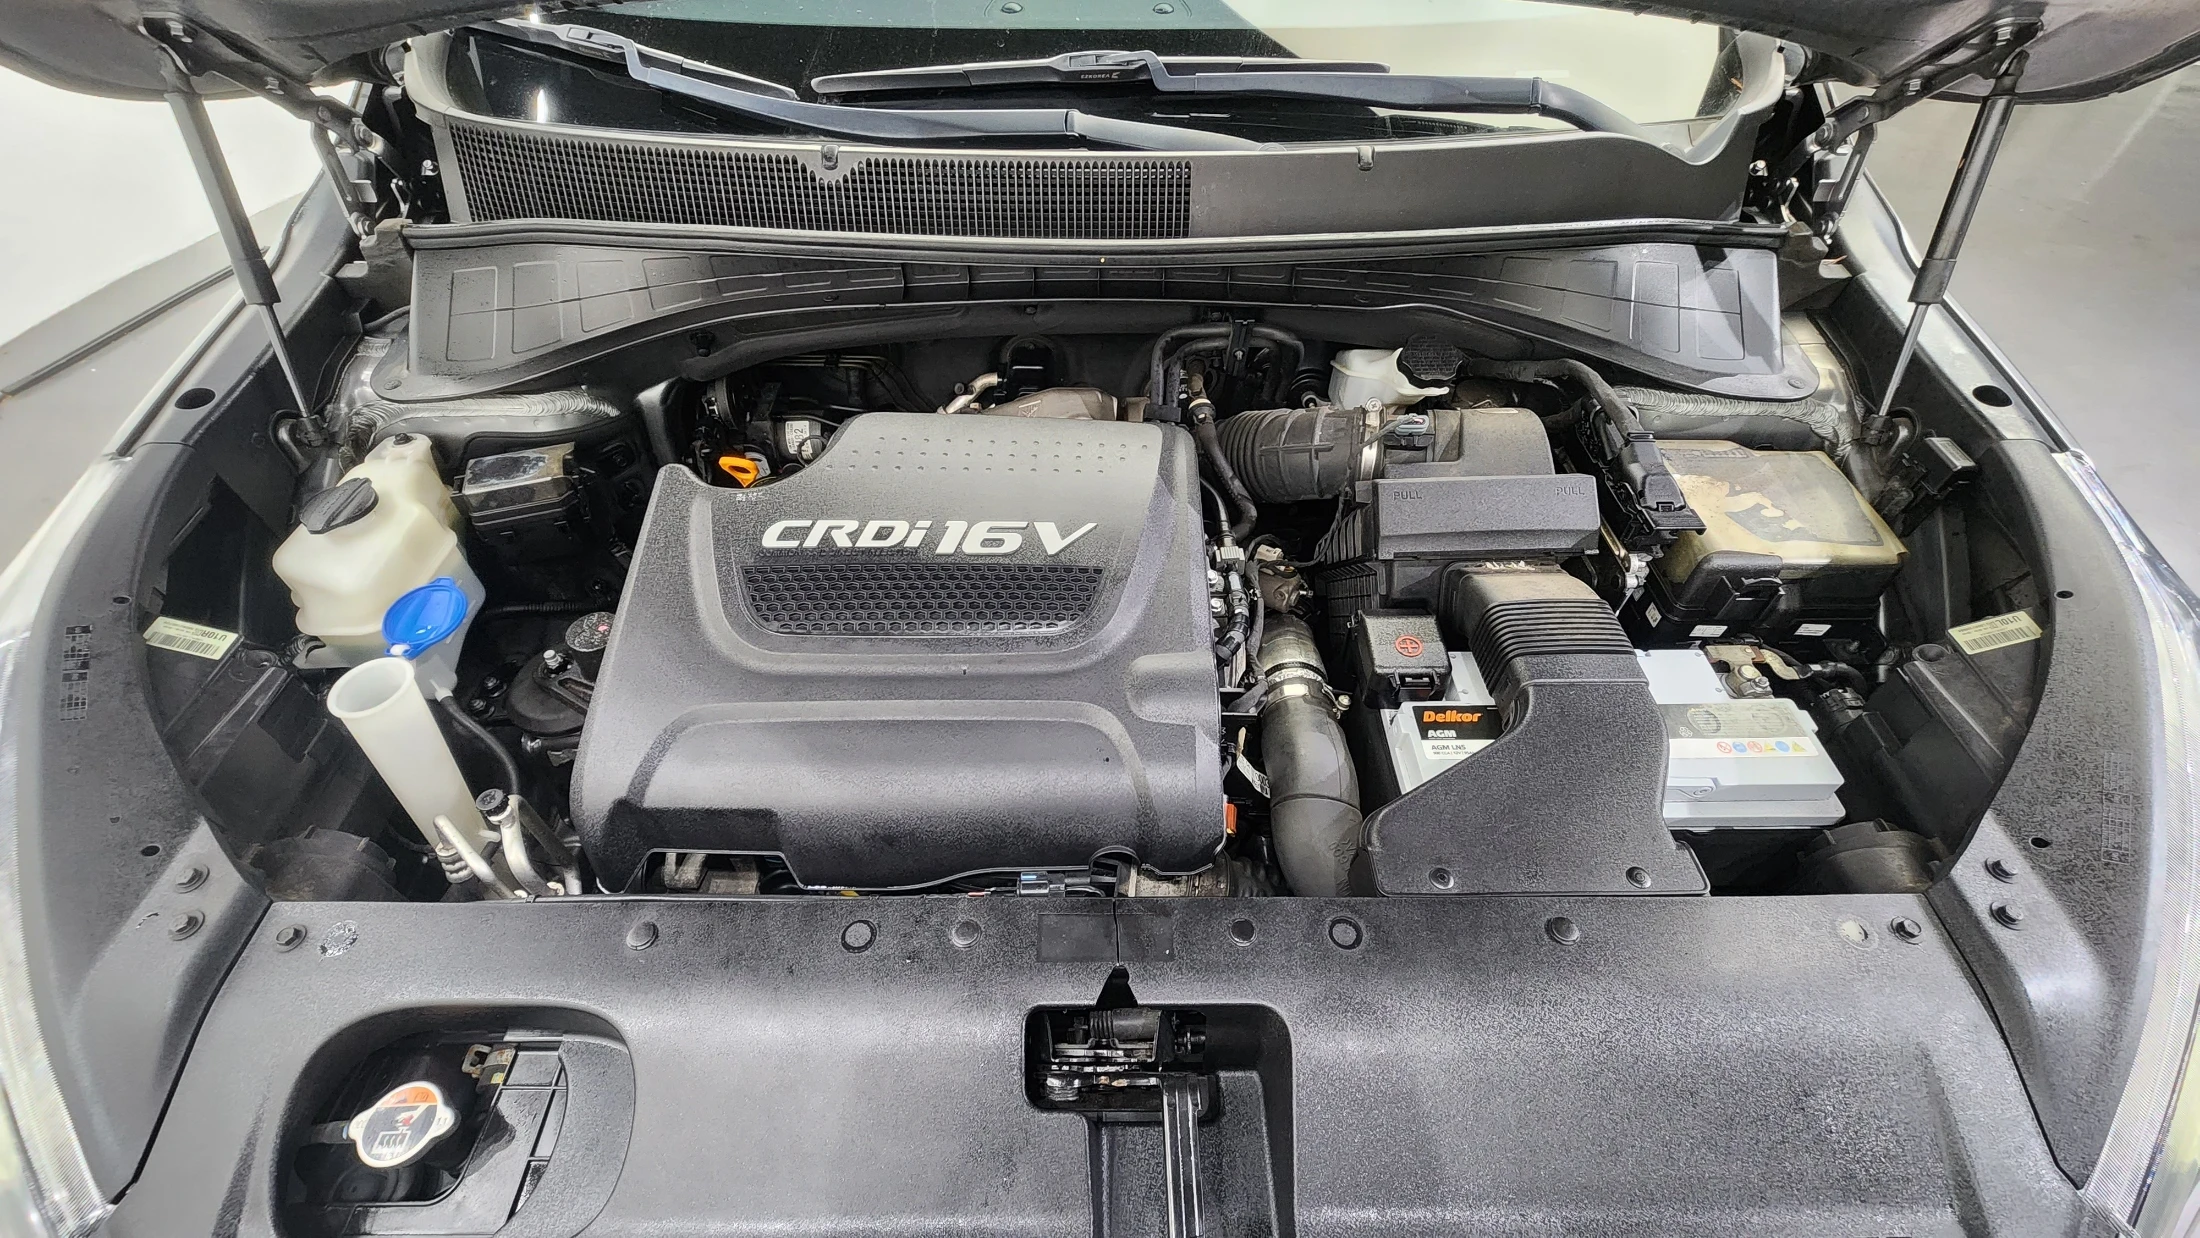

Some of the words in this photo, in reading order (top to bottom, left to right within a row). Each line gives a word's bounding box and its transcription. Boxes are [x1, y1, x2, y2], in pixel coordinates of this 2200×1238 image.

[1393, 490, 1423, 501] PULL
[1556, 486, 1585, 496] PULL
[761, 519, 934, 549] CRDi
[935, 520, 1098, 556] 16V
[1423, 710, 1482, 722] Delkor
[1428, 729, 1457, 737] AGM
